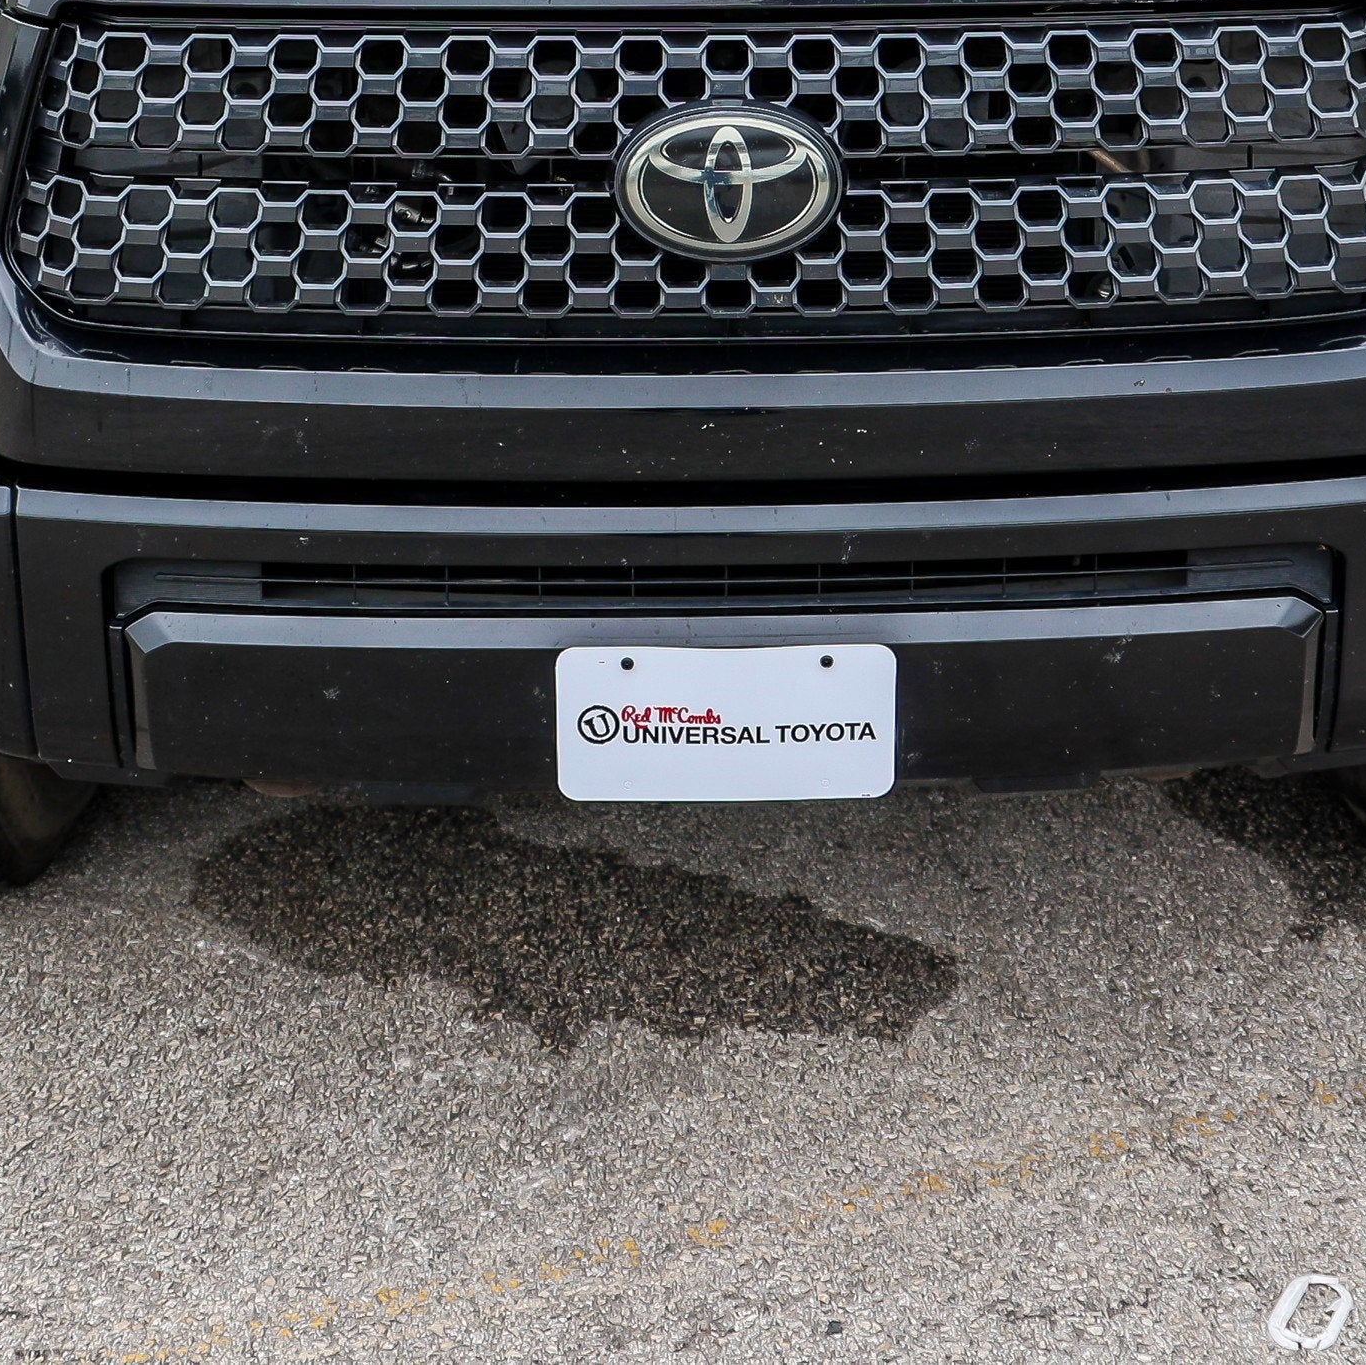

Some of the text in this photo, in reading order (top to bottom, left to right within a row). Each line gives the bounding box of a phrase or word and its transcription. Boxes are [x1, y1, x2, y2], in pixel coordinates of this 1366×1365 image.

[621, 705, 652, 729] Red
[653, 706, 722, 724] McCombs
[622, 721, 877, 746] UNIVERSAL TOYOTA
